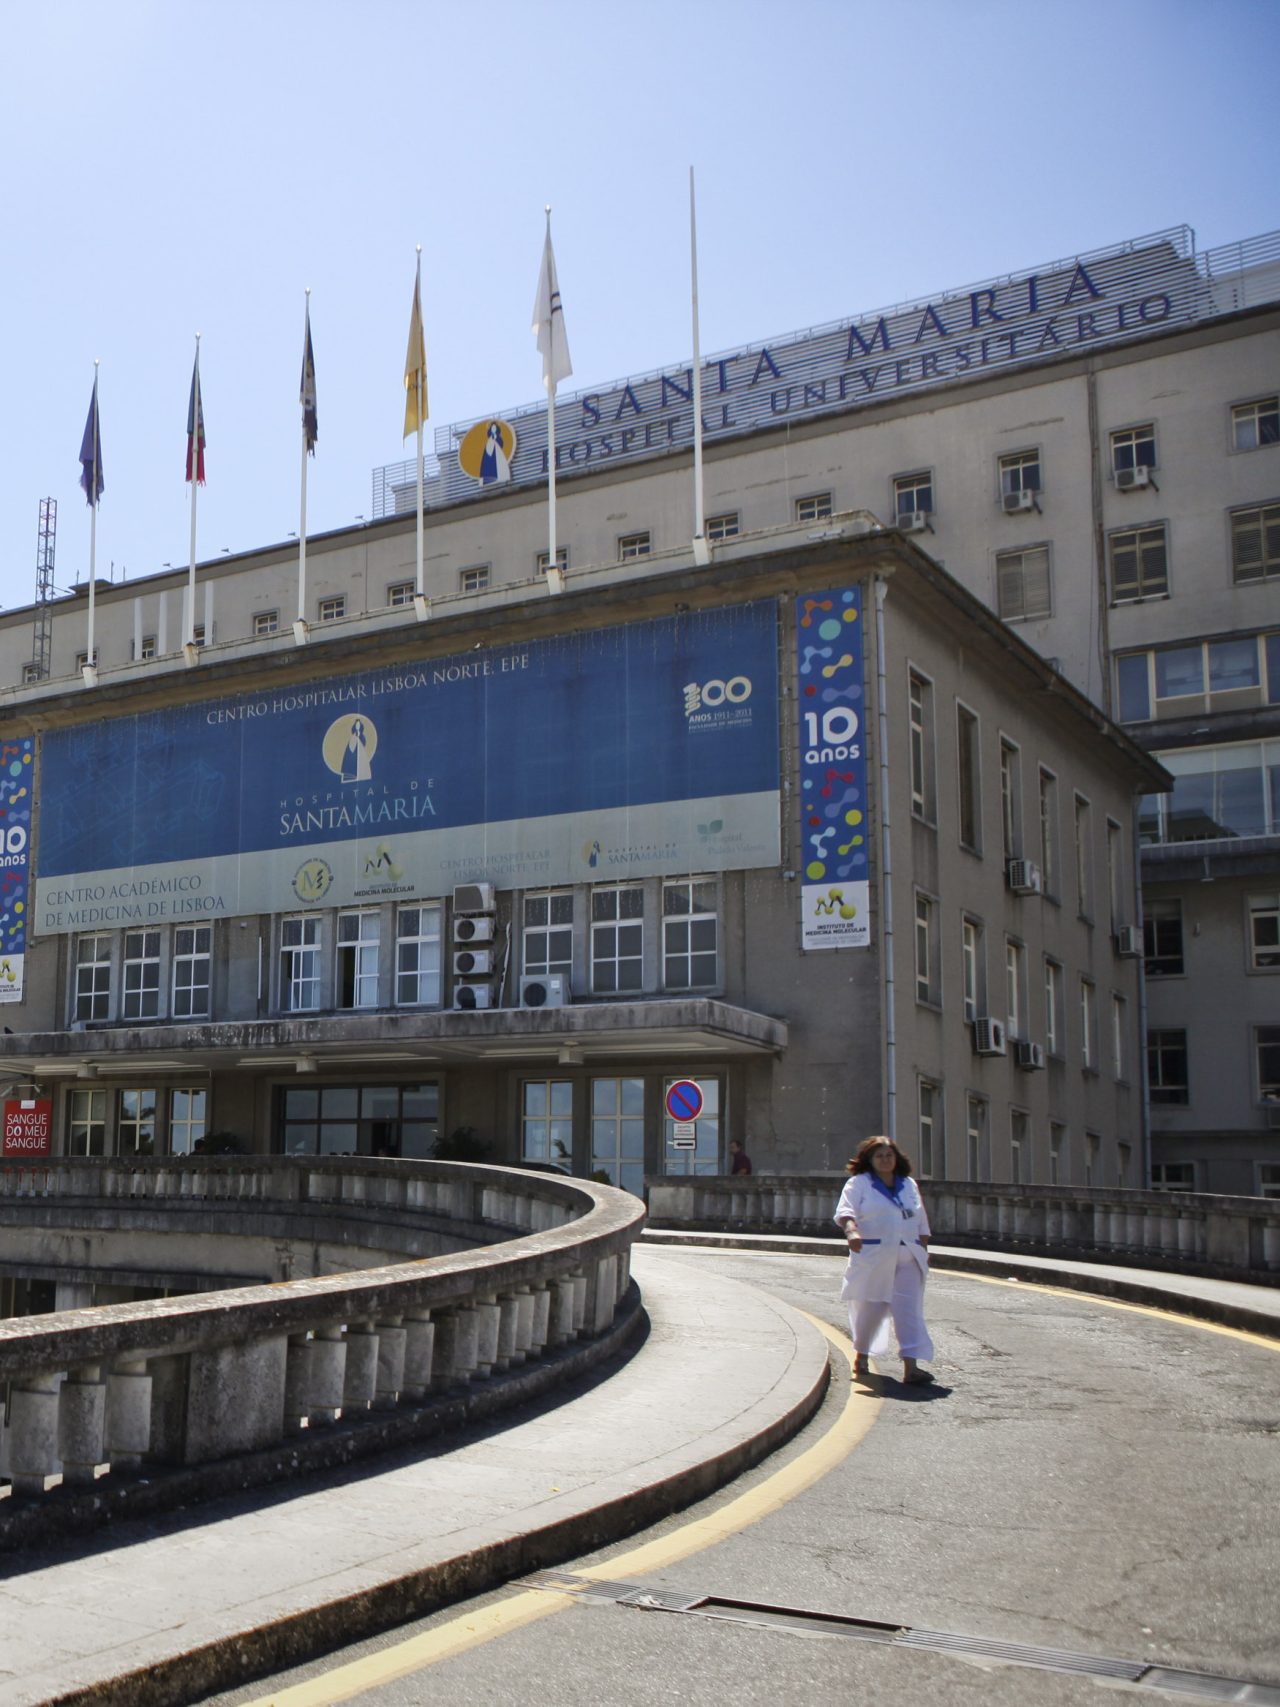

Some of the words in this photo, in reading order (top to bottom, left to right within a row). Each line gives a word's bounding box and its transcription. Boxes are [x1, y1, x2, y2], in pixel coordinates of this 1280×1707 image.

[581, 348, 783, 429] SANTA
[845, 263, 1105, 361] MARIA
[541, 403, 736, 473] HOSPITAL
[771, 294, 1170, 415] UNIVERSITÁRIO
[207, 702, 268, 725] CENTRO
[273, 684, 367, 714] HOSPITALAR
[372, 673, 427, 696] LISBOA
[501, 654, 529, 672] EPE
[683, 676, 752, 717] 100
[689, 714, 712, 723] ANOS
[804, 706, 858, 746] 10
[805, 744, 860, 764] anos
[280, 785, 389, 808] HOSPITAL
[410, 778, 434, 790] DE
[280, 795, 436, 835] SANTAMARIA
[46, 886, 105, 906] CENTRO
[109, 875, 202, 898] ACADÉMICO
[354, 889, 380, 897] MEDICINA
[381, 885, 415, 895] MOLECULAR
[45, 912, 63, 927] DE
[67, 904, 142, 924] MEDICINA
[148, 901, 166, 916] DE
[172, 896, 225, 913] LISBOA
[6, 1125, 22, 1137] DO
[24, 1126, 47, 1137] MEU
[7, 1113, 47, 1125] SANGUE
[5, 1137, 46, 1149] SANGUE
